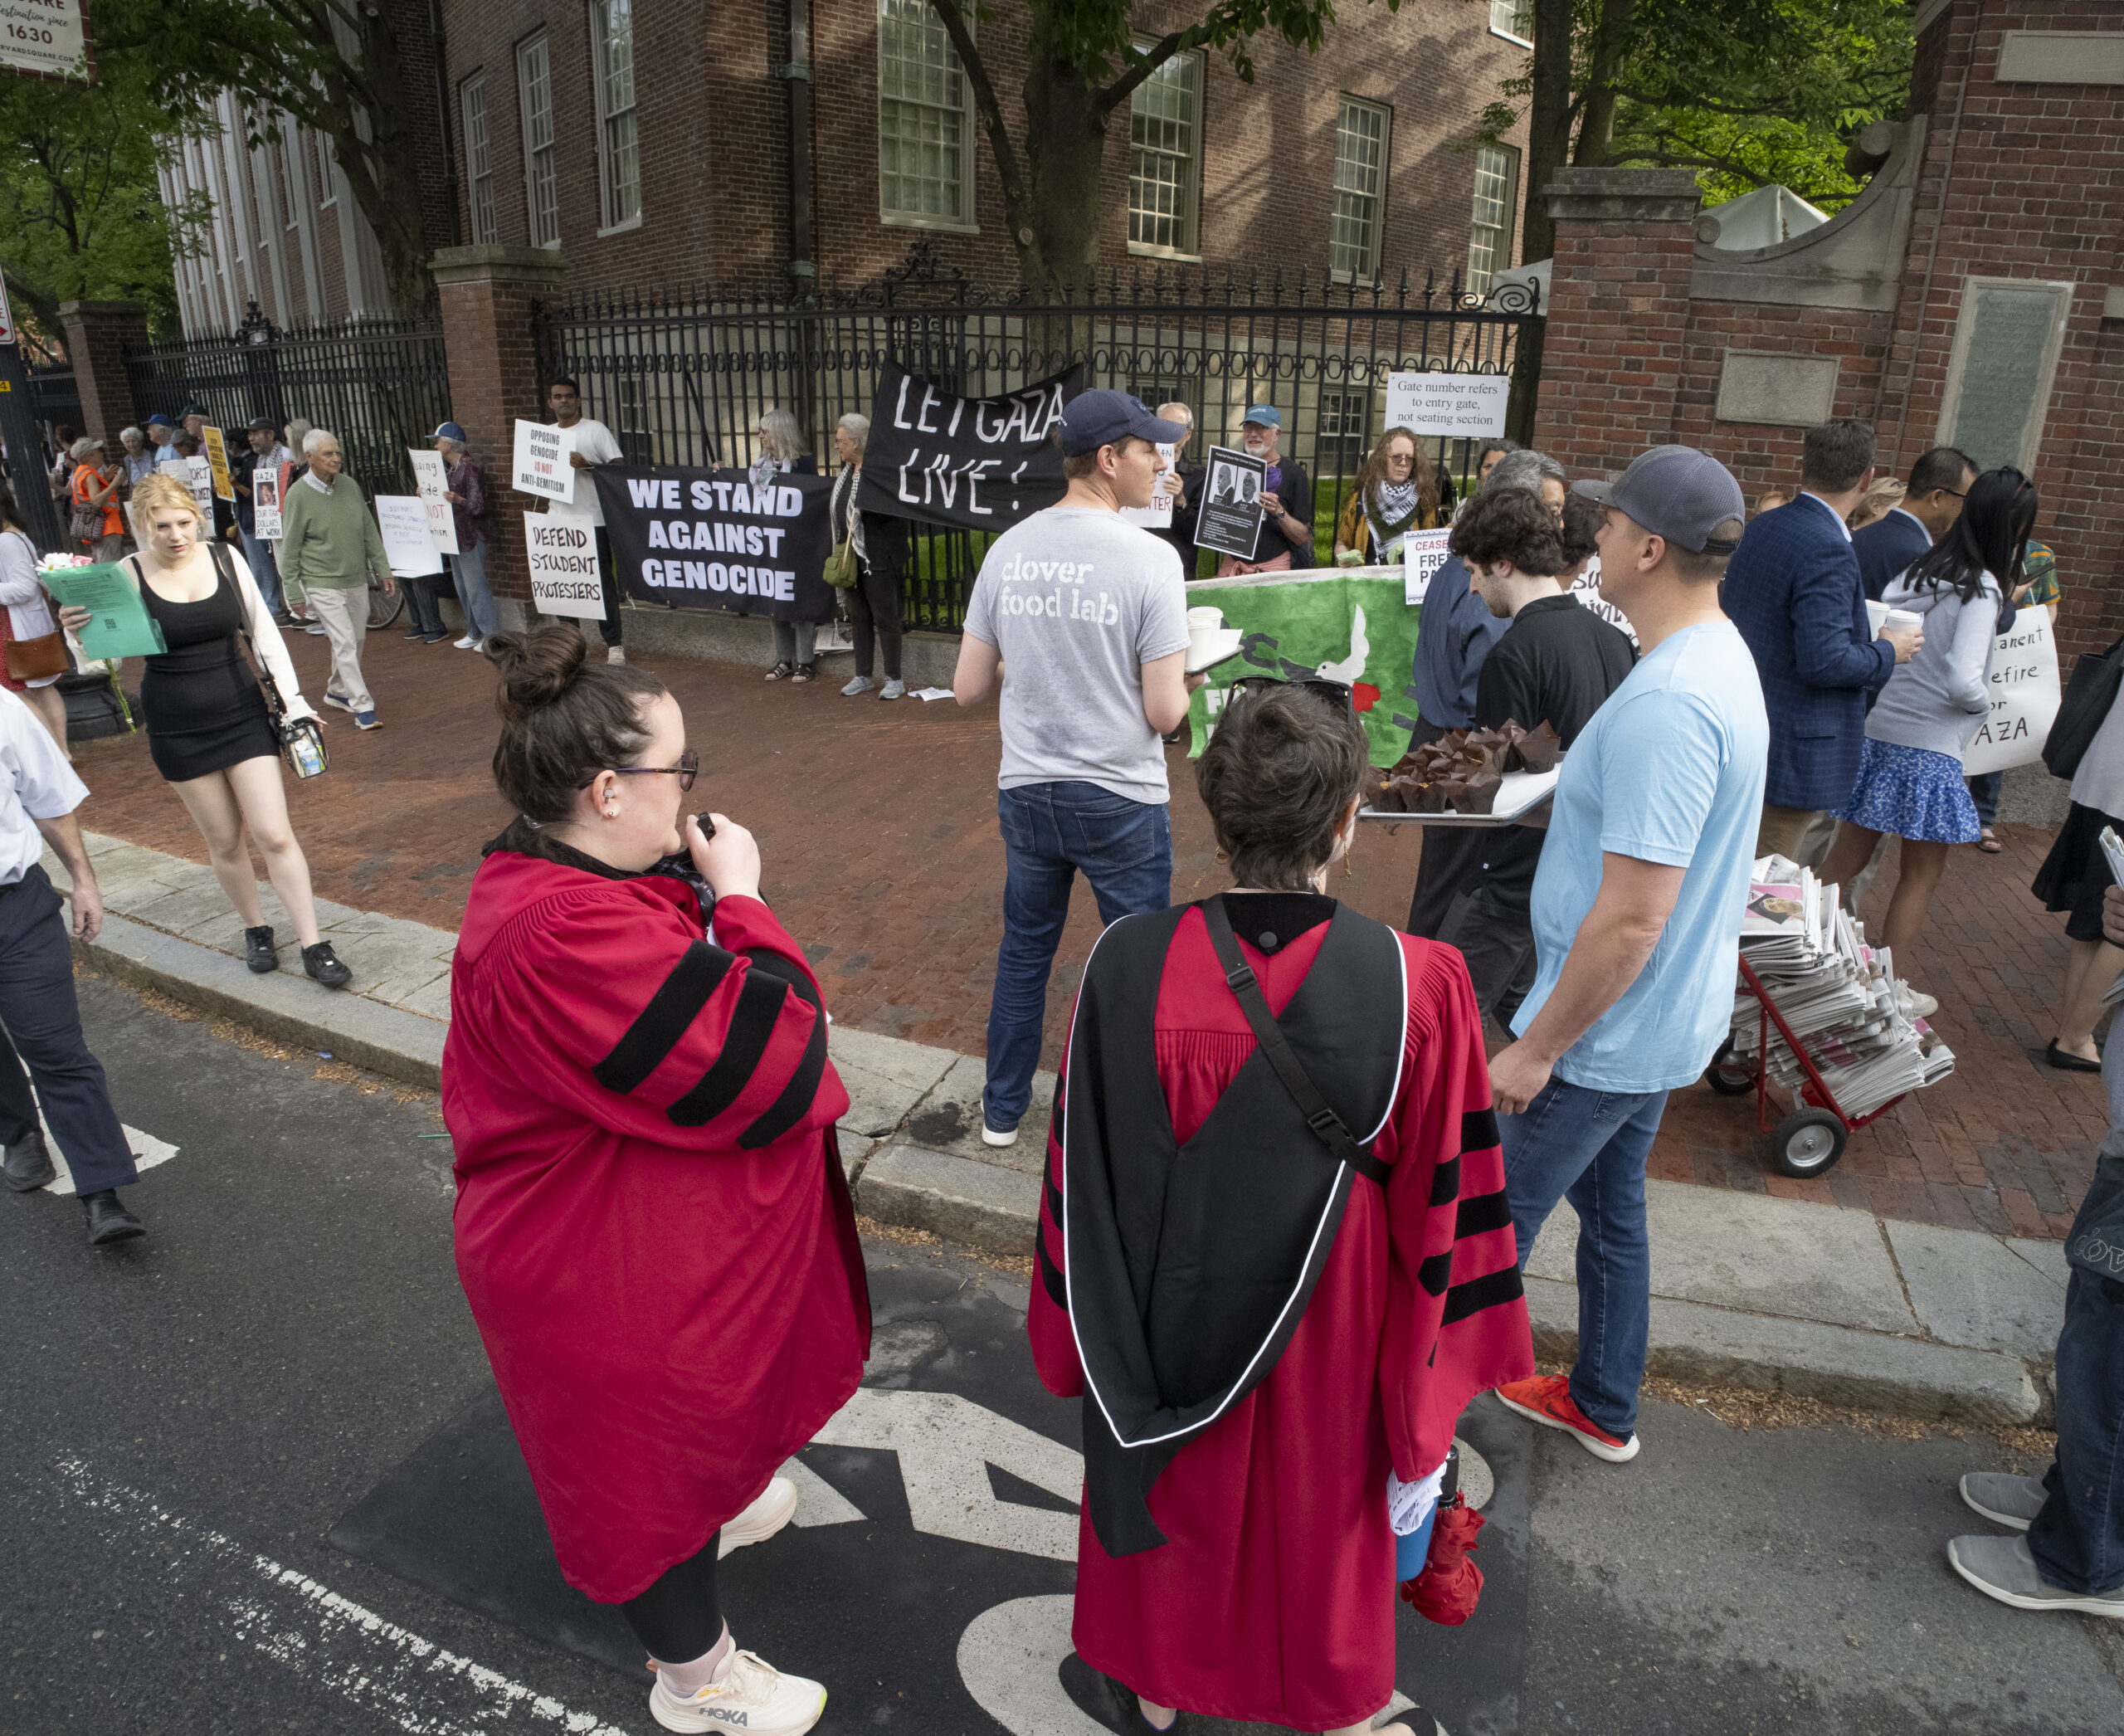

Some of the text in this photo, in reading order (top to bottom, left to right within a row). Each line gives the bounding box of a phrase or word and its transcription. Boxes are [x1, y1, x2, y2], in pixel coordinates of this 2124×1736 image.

[0, 5, 69, 27] estination since
[7, 23, 53, 45] 1630
[0, 44, 75, 63] RVARDSQUARE.COM
[1397, 380, 1498, 394] Gate number refers
[976, 383, 1064, 443] GAZA
[1412, 397, 1481, 412] to entry gate,
[1397, 412, 1493, 426] not seating section
[530, 428, 560, 446] OPPOSING
[530, 444, 558, 461] GENOCIDE
[189, 466, 209, 480] ORT
[255, 472, 275, 480] GAZA
[534, 461, 553, 475] IS NOT
[521, 473, 565, 494] ANTI-SEMITISM
[627, 479, 803, 517] WE STAND
[256, 510, 267, 518] OUR
[426, 505, 445, 519] NOT
[256, 529, 280, 537] AT WORK
[533, 527, 587, 549] DEFEND
[648, 520, 786, 558] AGAINST
[1415, 539, 1449, 551] CEASE
[531, 553, 596, 575] STUDENT
[1001, 553, 1094, 584] clover
[641, 558, 796, 601] GENOCIDE
[533, 581, 601, 601] PROTESTERS
[1001, 586, 1119, 626] food lab
[1995, 624, 2044, 651] anent
[1991, 666, 2039, 684] efire
[1975, 717, 2028, 746] AZA
[699, 1707, 748, 1728] HOKA
